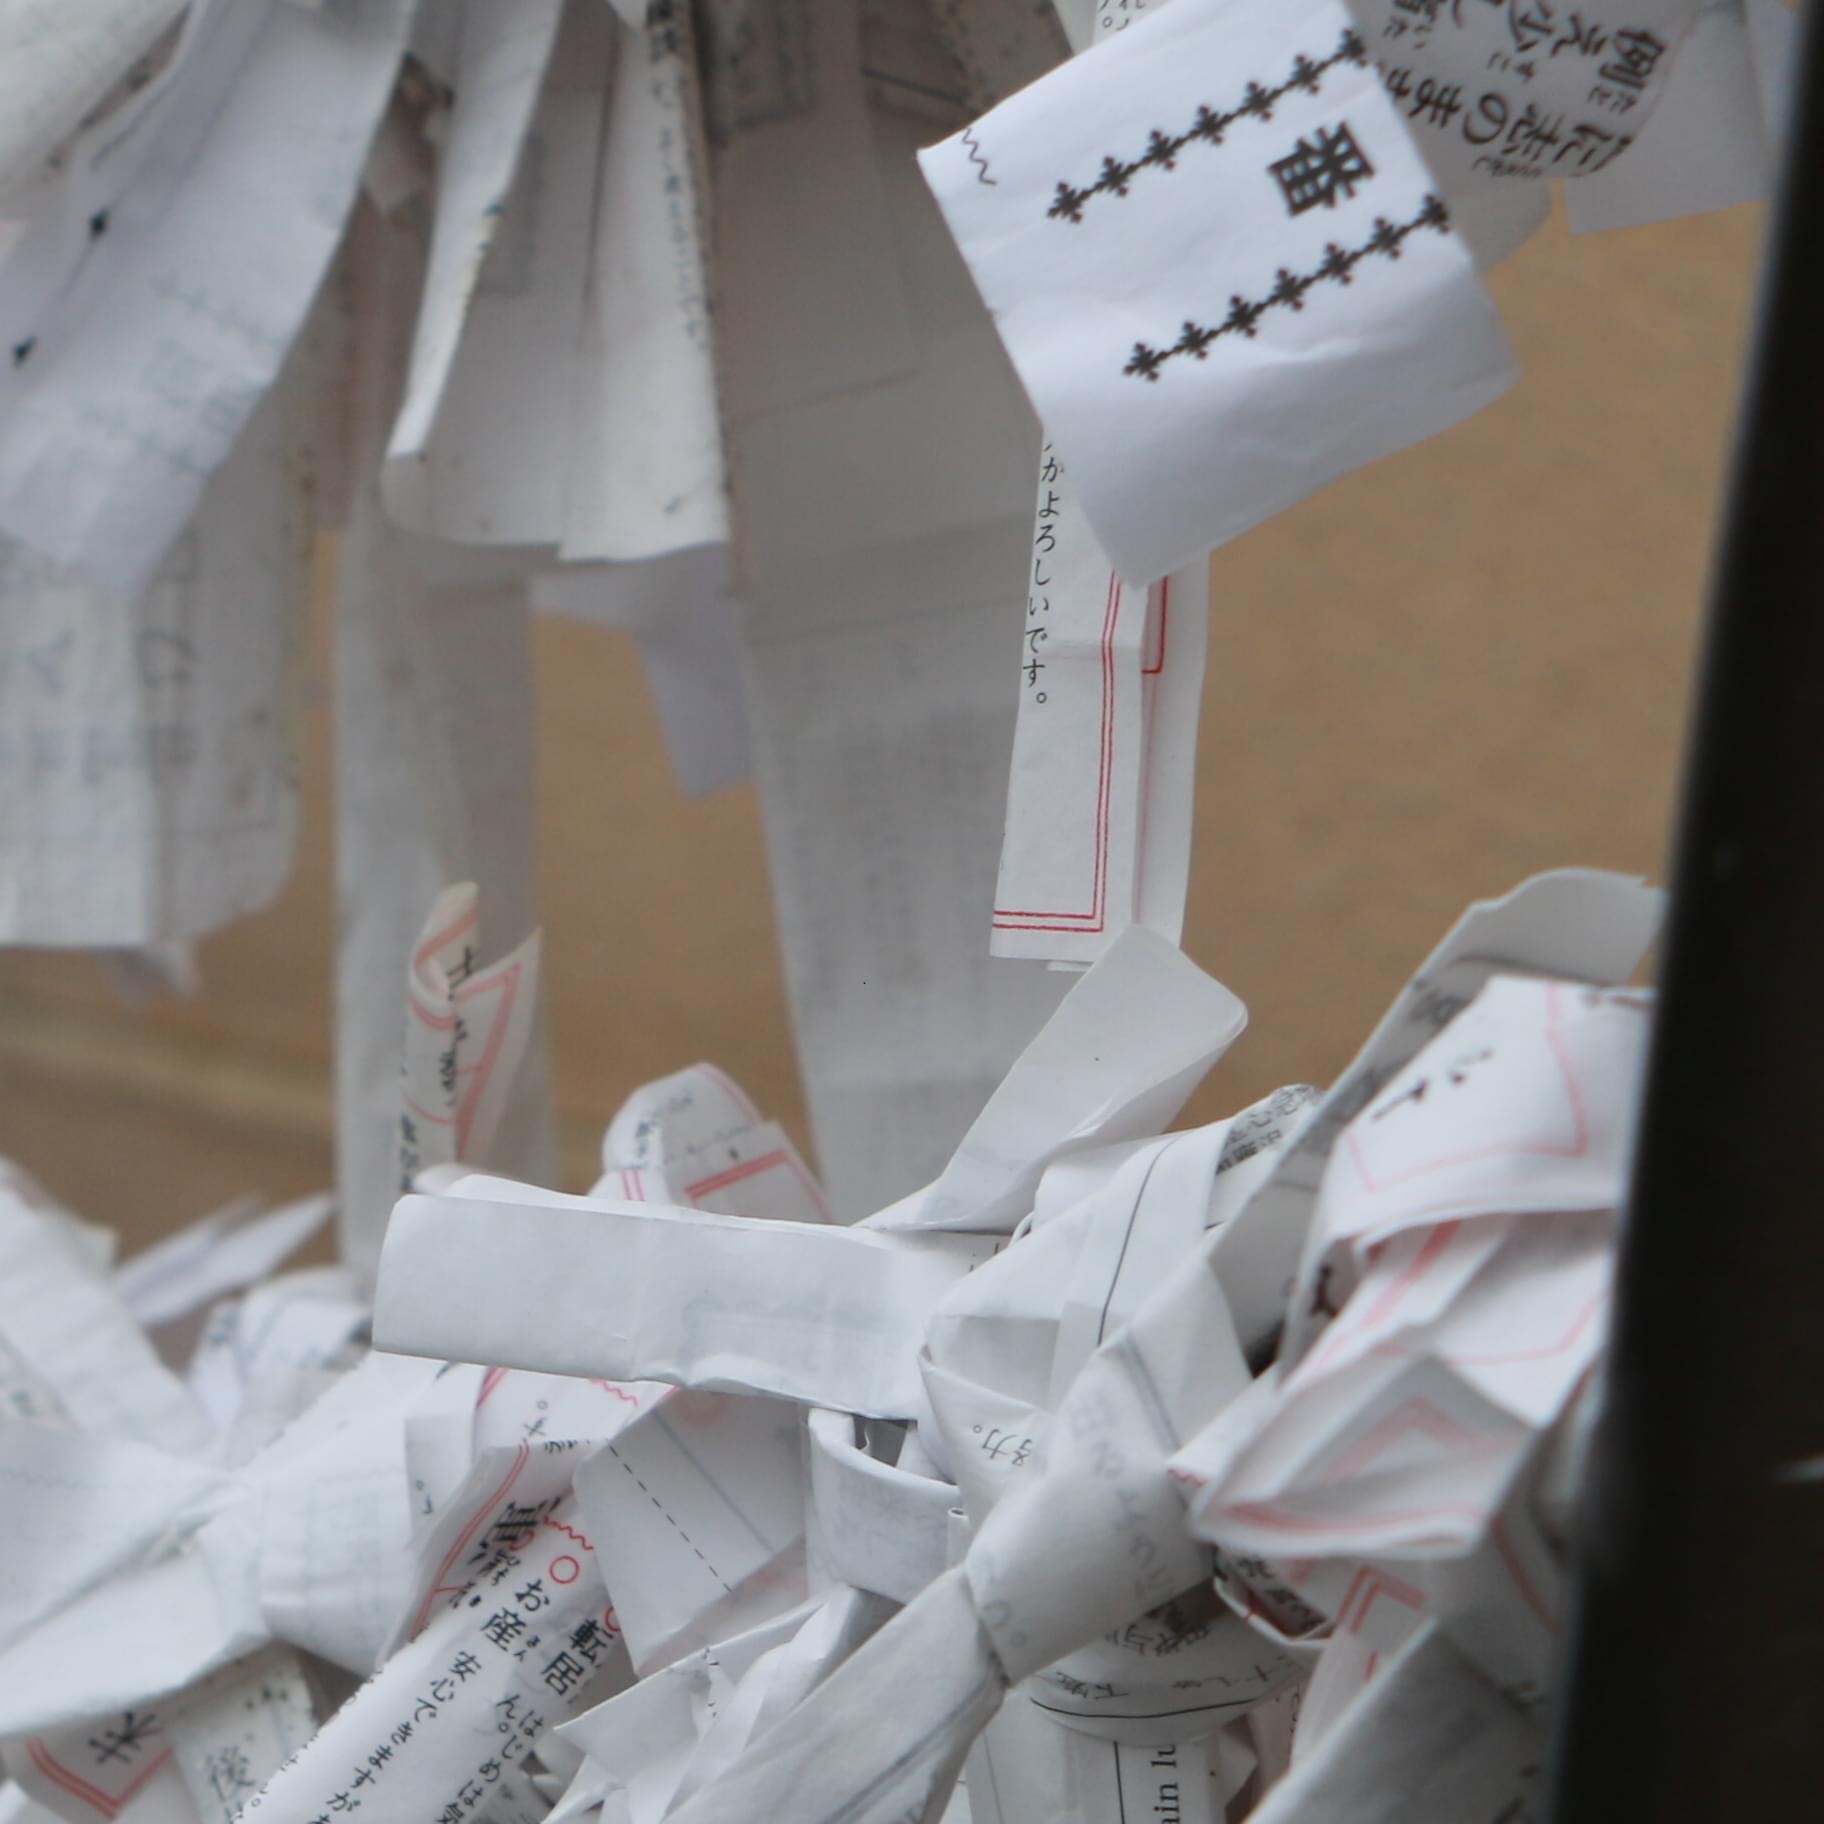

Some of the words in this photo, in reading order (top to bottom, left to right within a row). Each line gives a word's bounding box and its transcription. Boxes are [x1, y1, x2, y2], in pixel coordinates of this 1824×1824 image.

[1266, 119, 1375, 219] 番
[480, 1578, 551, 1652] お産
[540, 1616, 615, 1696] 転居
